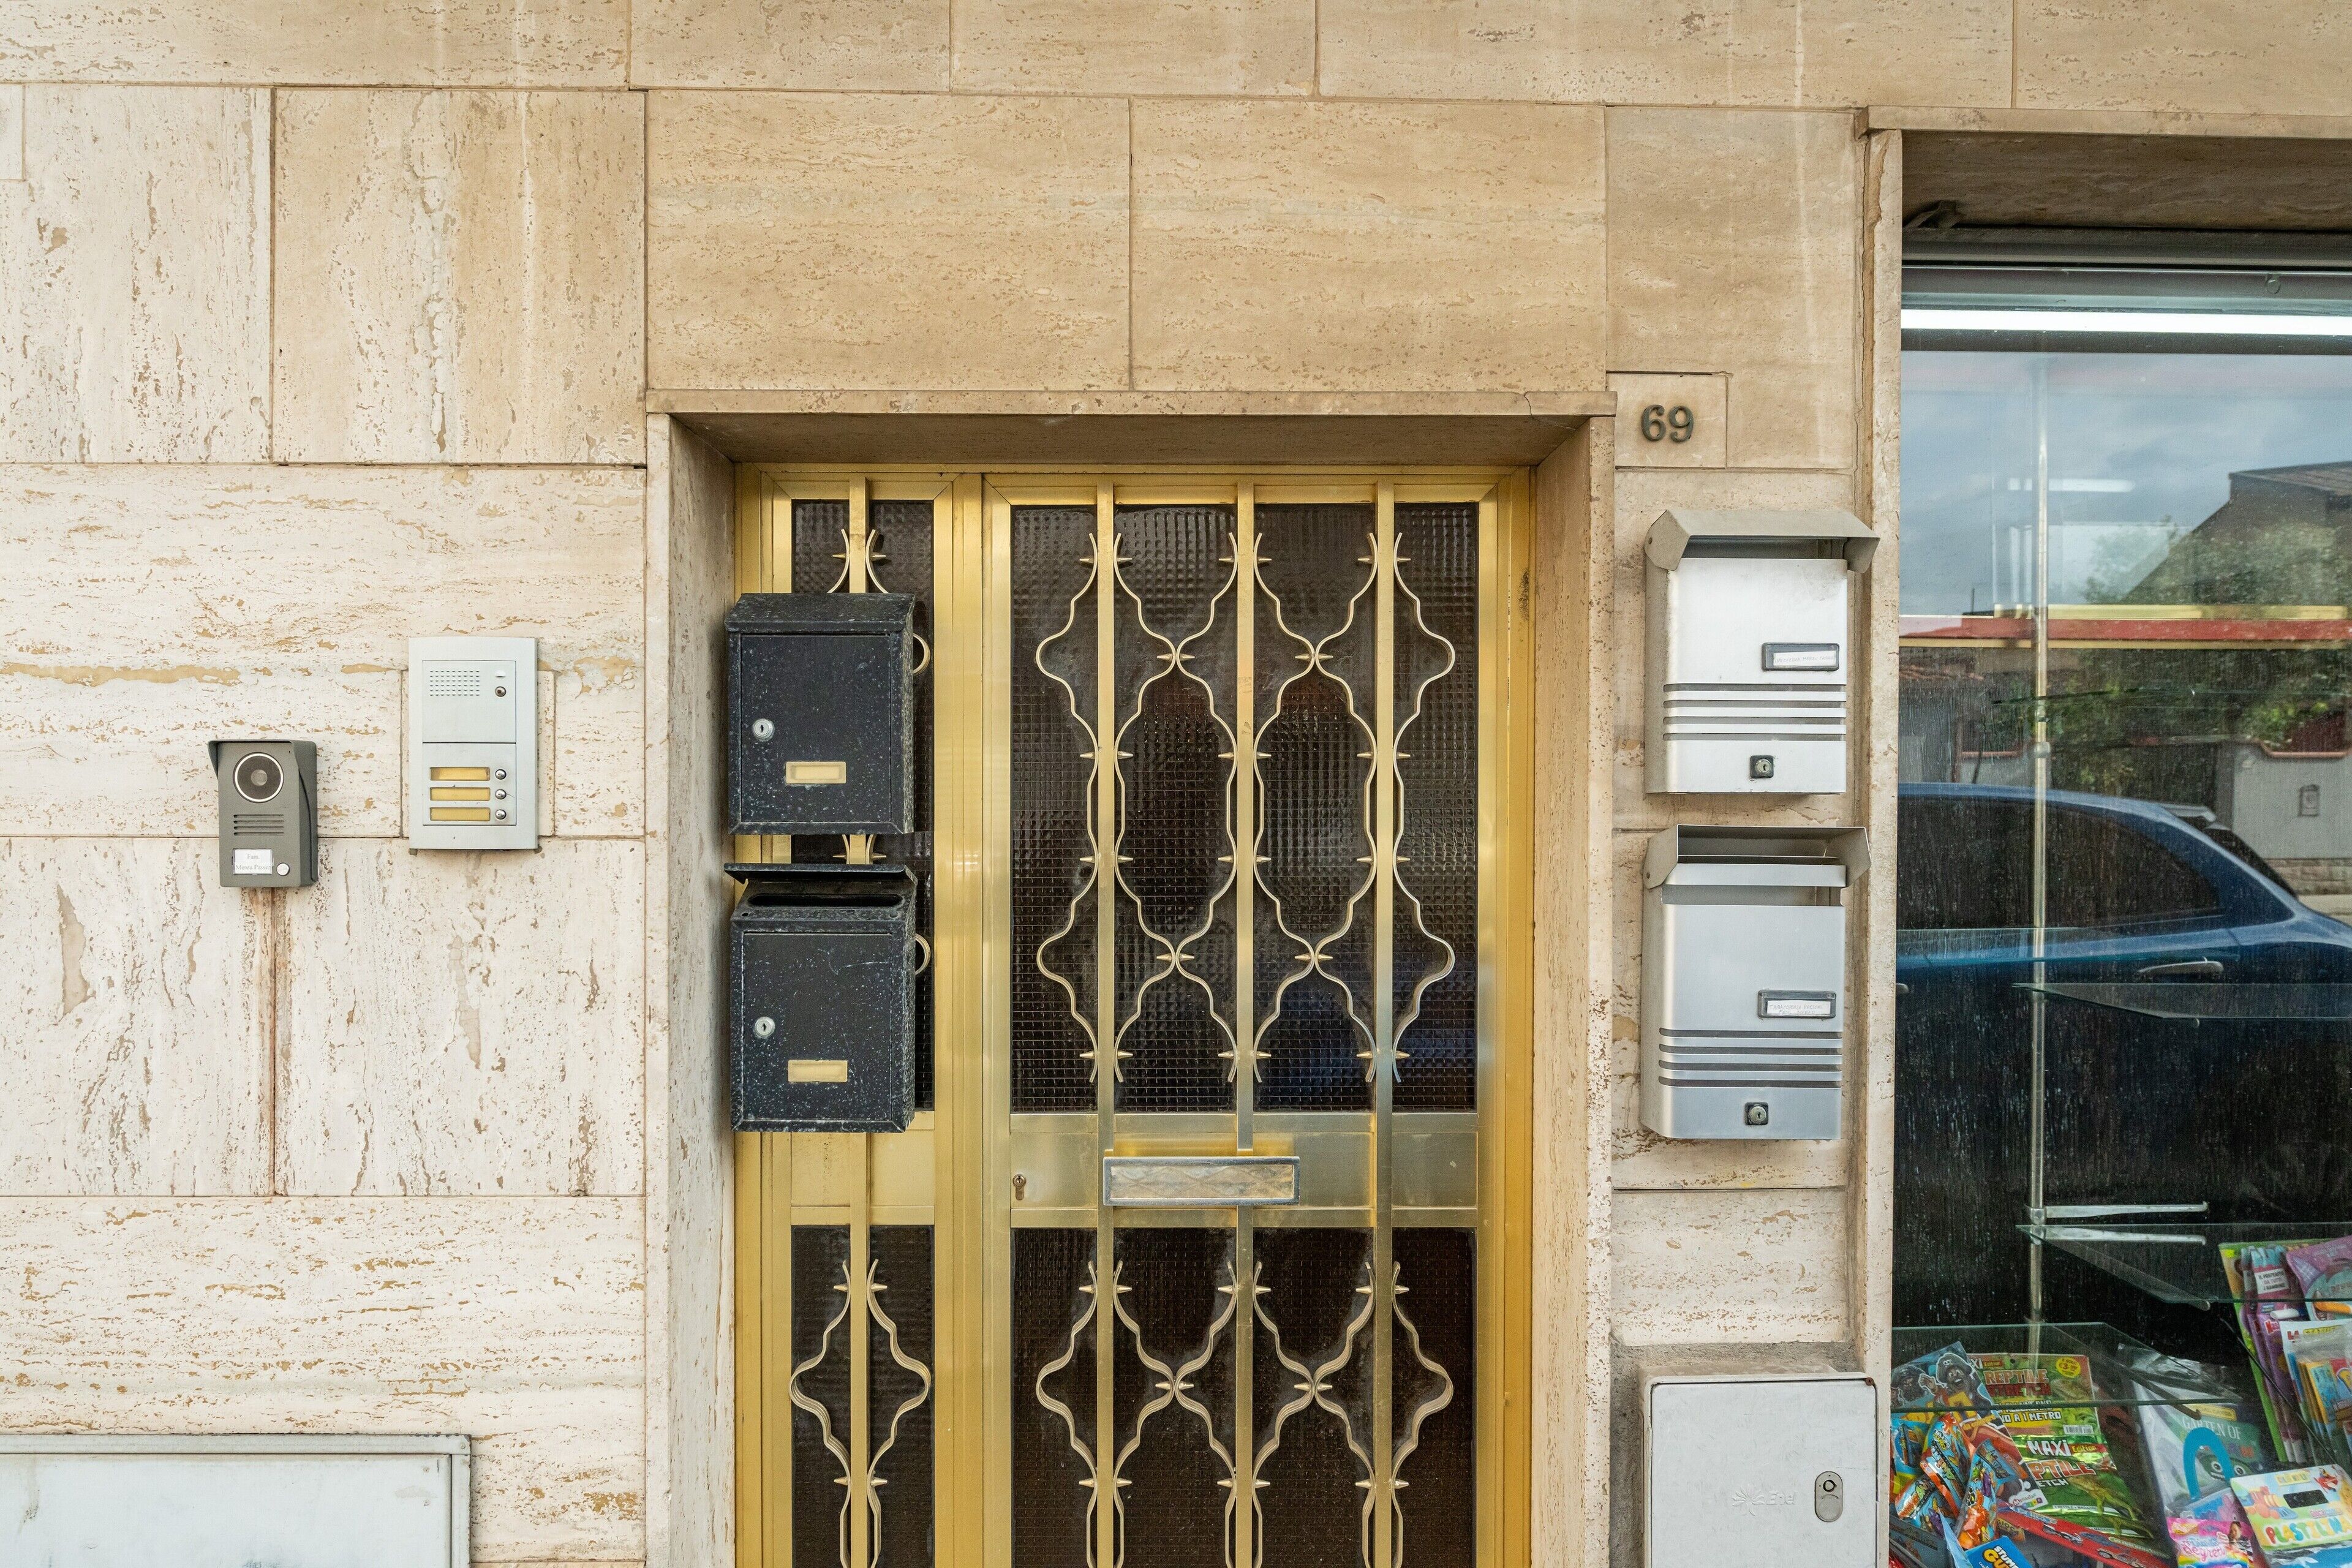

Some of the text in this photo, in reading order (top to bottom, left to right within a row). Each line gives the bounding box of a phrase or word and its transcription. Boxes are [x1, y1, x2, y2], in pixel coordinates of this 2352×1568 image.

[1641, 404, 1694, 443] 69
[1983, 1369, 2049, 1385] REPTILE
[2014, 1414, 2021, 1422] A
[2029, 1411, 2062, 1422] METRO
[2228, 1425, 2242, 1440] OF
[2026, 1439, 2072, 1457] MAXI
[2025, 1459, 2097, 1480] PTILE
[2036, 1478, 2070, 1488] ETCH
